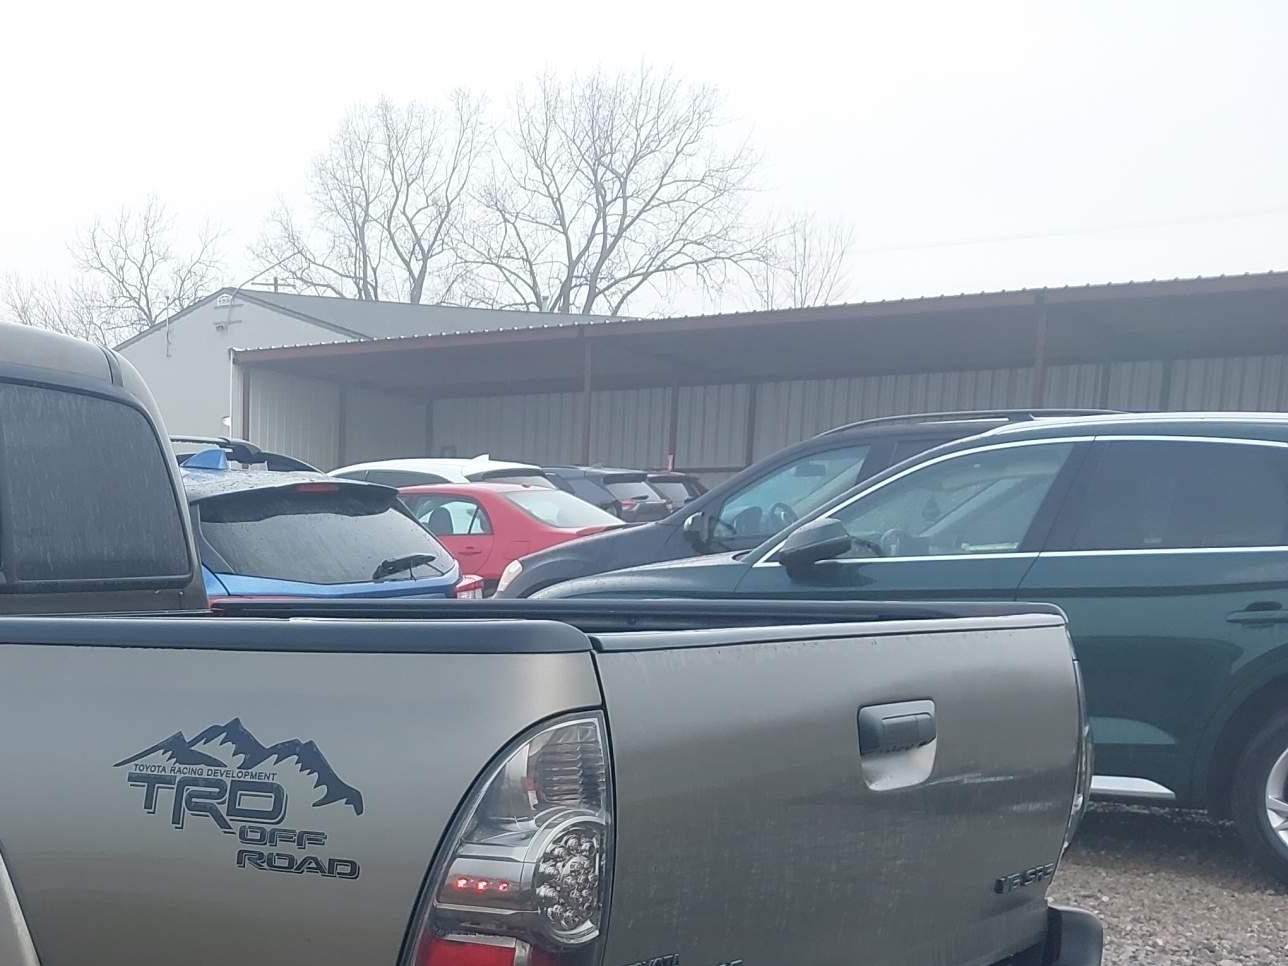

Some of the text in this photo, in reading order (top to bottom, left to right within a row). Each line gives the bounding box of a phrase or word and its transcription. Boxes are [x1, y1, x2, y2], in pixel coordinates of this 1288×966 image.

[133, 763, 278, 781] TOYOTA RACING DEVELOPMENT
[127, 772, 288, 834] TRD
[239, 825, 328, 850] OFF
[236, 849, 361, 880] ROAD
